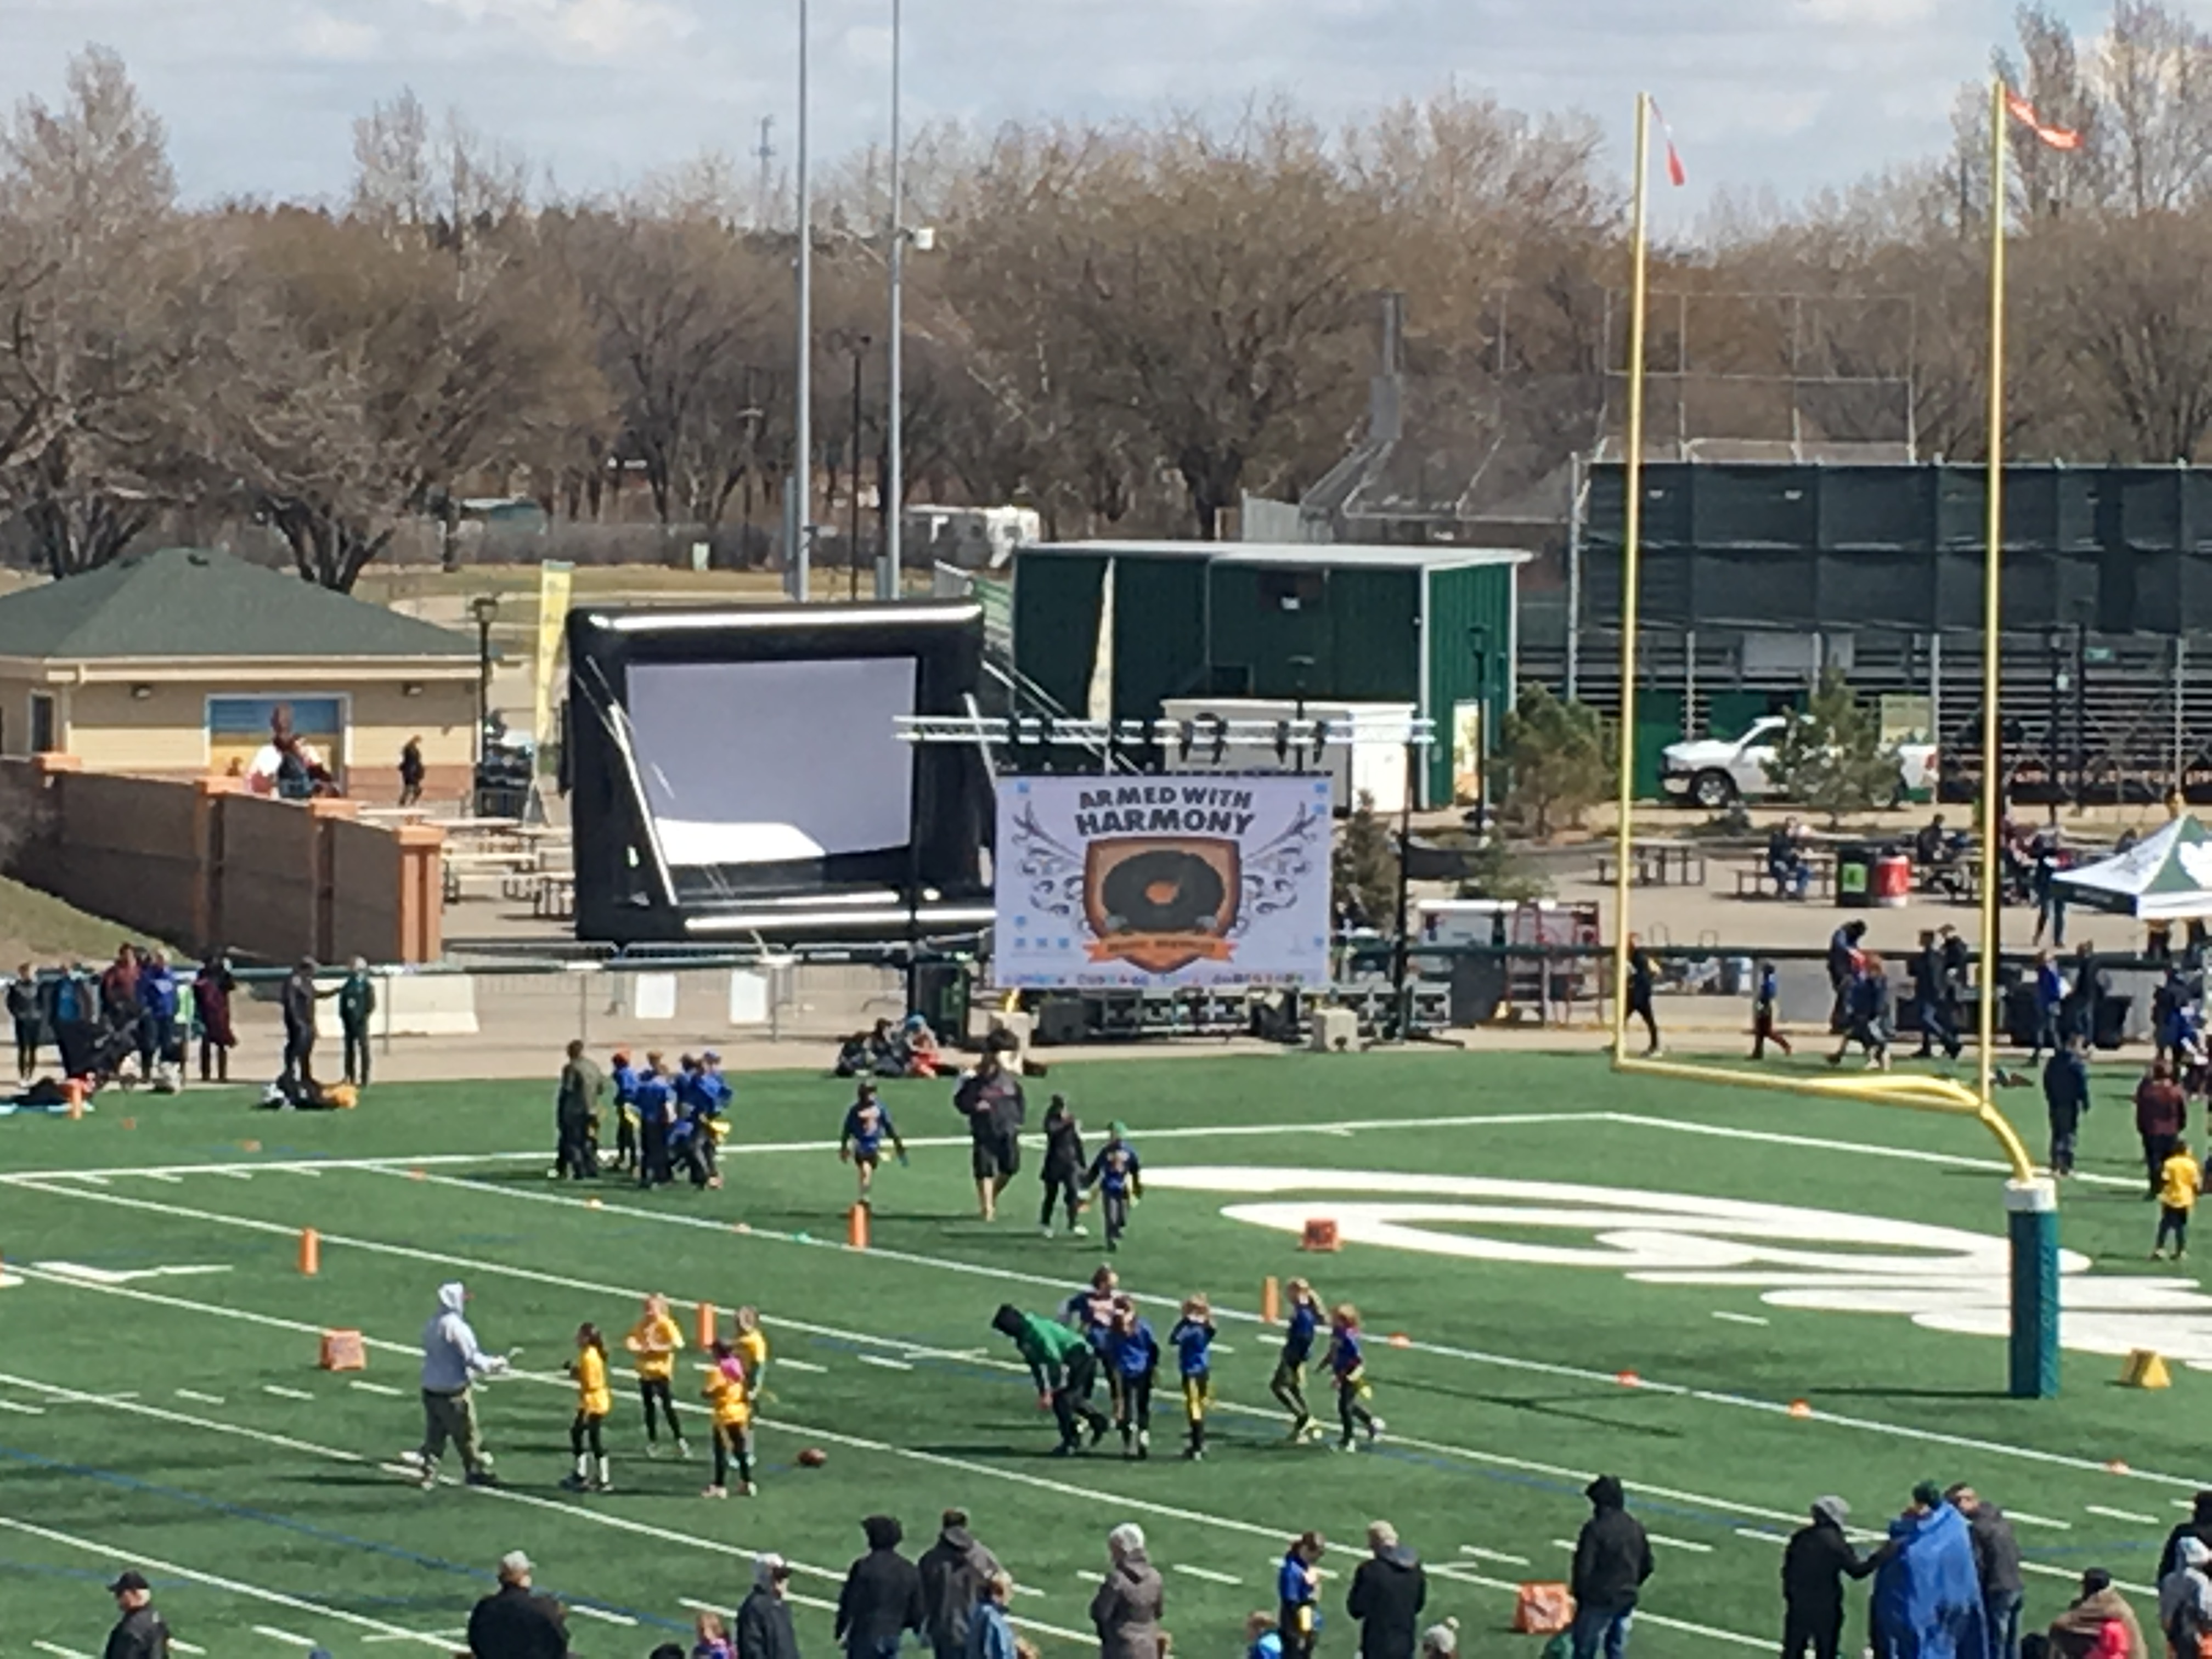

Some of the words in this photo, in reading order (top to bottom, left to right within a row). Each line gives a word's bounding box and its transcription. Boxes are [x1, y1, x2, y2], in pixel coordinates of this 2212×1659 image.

[1079, 787, 1176, 809] ARMED
[1181, 787, 1253, 809] WITH
[1075, 809, 1255, 836] HARMONY
